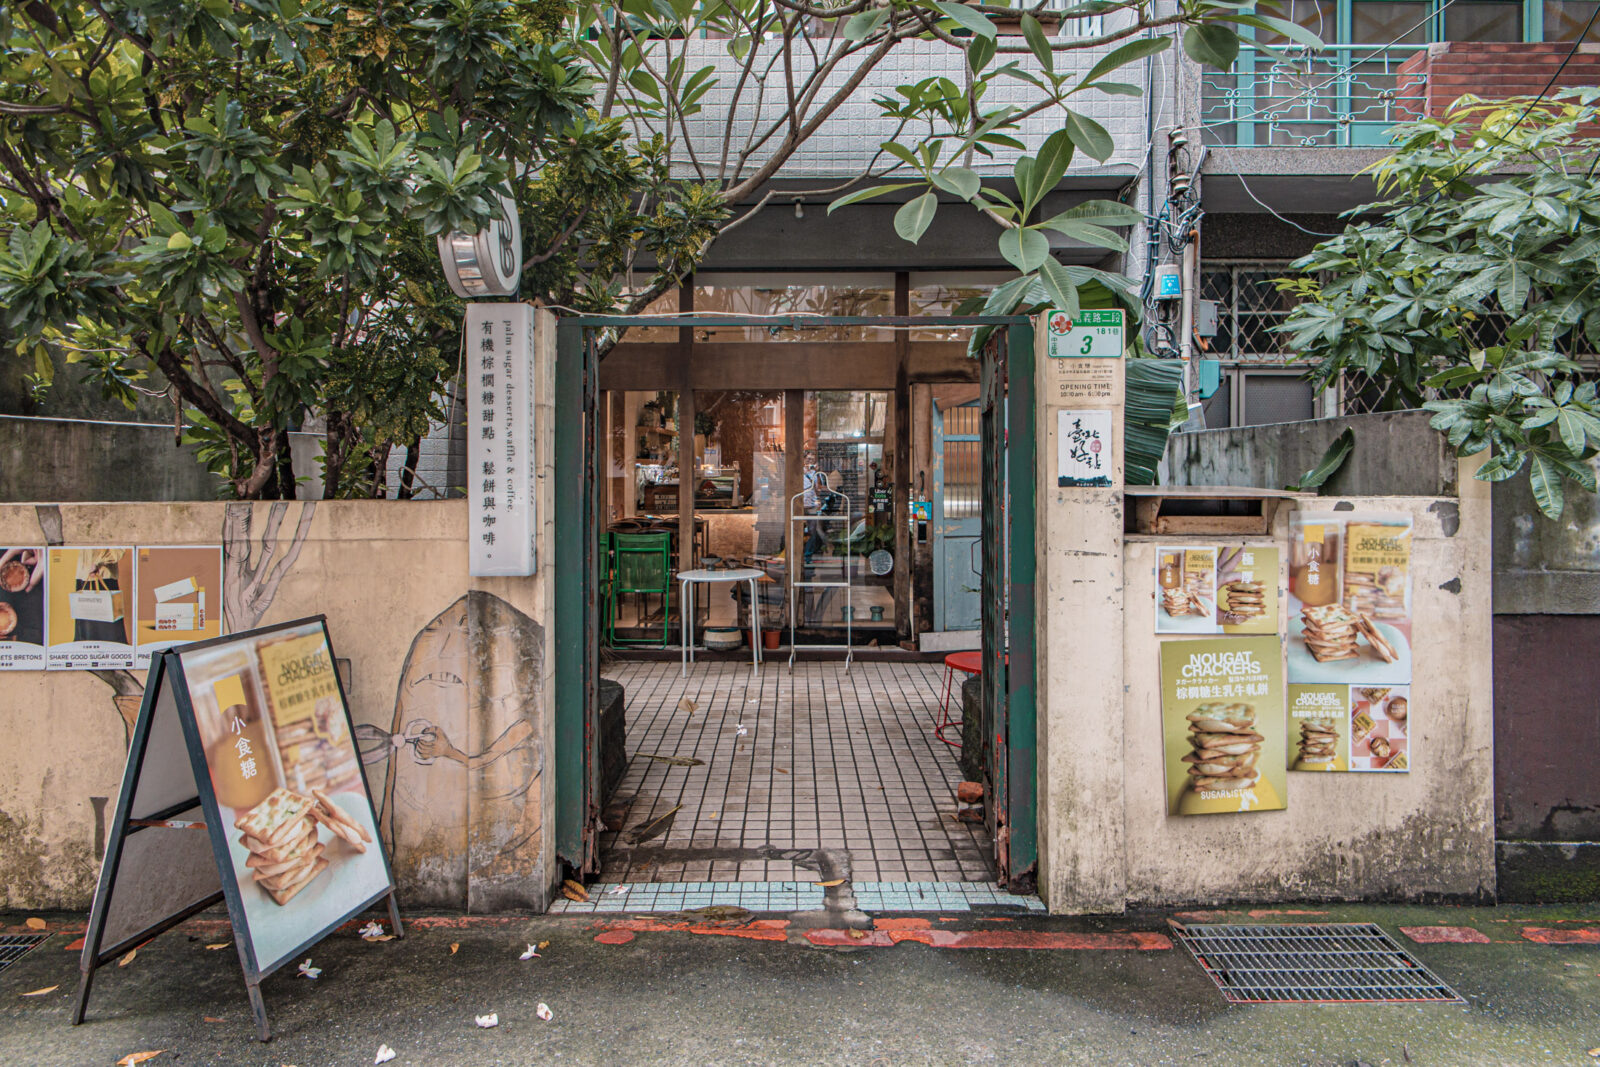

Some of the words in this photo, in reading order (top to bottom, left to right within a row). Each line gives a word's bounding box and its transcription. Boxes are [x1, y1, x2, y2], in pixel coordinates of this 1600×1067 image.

[503, 320, 514, 346] palm
[1080, 335, 1093, 354] 3
[503, 350, 512, 379] sugar
[506, 478, 516, 513] coffee.
[1307, 547, 1320, 585] 小食糖
[281, 652, 323, 674] NOUGAT
[1182, 661, 1261, 677] CRACKERS
[1189, 651, 1253, 666] NOUGAT
[278, 660, 331, 686] CRACKERS
[1295, 698, 1341, 706] CRACKERS
[1300, 692, 1337, 700] NOUGAT
[231, 715, 257, 780] 小食糖
